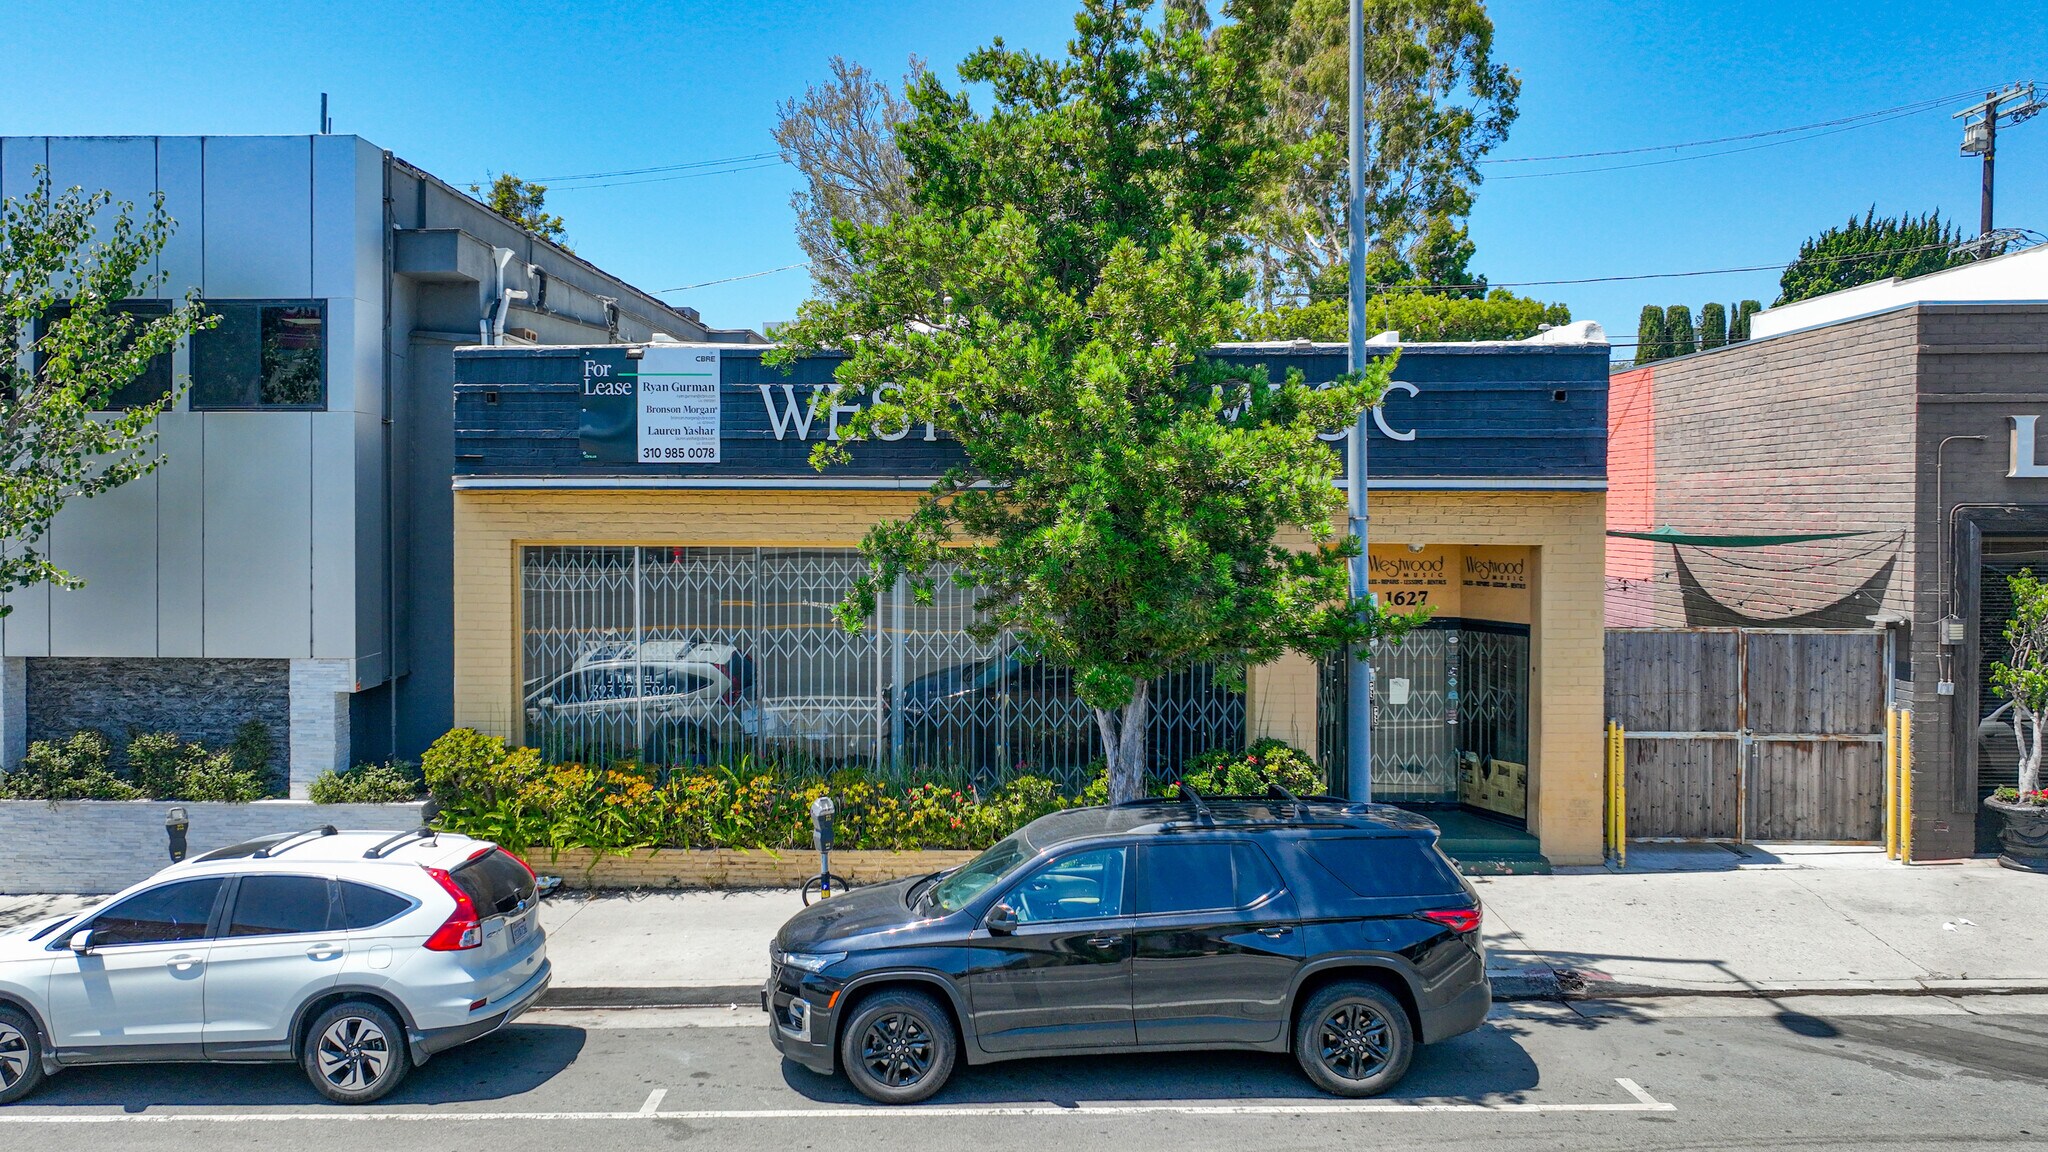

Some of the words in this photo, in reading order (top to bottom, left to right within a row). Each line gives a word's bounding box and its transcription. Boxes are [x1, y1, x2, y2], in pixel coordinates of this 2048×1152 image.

[695, 355, 716, 363] CBRE
[583, 360, 612, 377] For
[583, 378, 632, 396] Lease
[642, 382, 669, 394] Ryan
[671, 382, 715, 392] Gurman
[646, 405, 681, 414] Bronson
[648, 426, 682, 435] Lauren
[683, 426, 715, 435] Yashar
[643, 448, 662, 458] 310
[664, 448, 685, 459] 985
[688, 448, 715, 459] 0078
[1368, 554, 1444, 577] Westwood
[1465, 556, 1524, 580] Westwood
[1385, 590, 1429, 606] 1627
